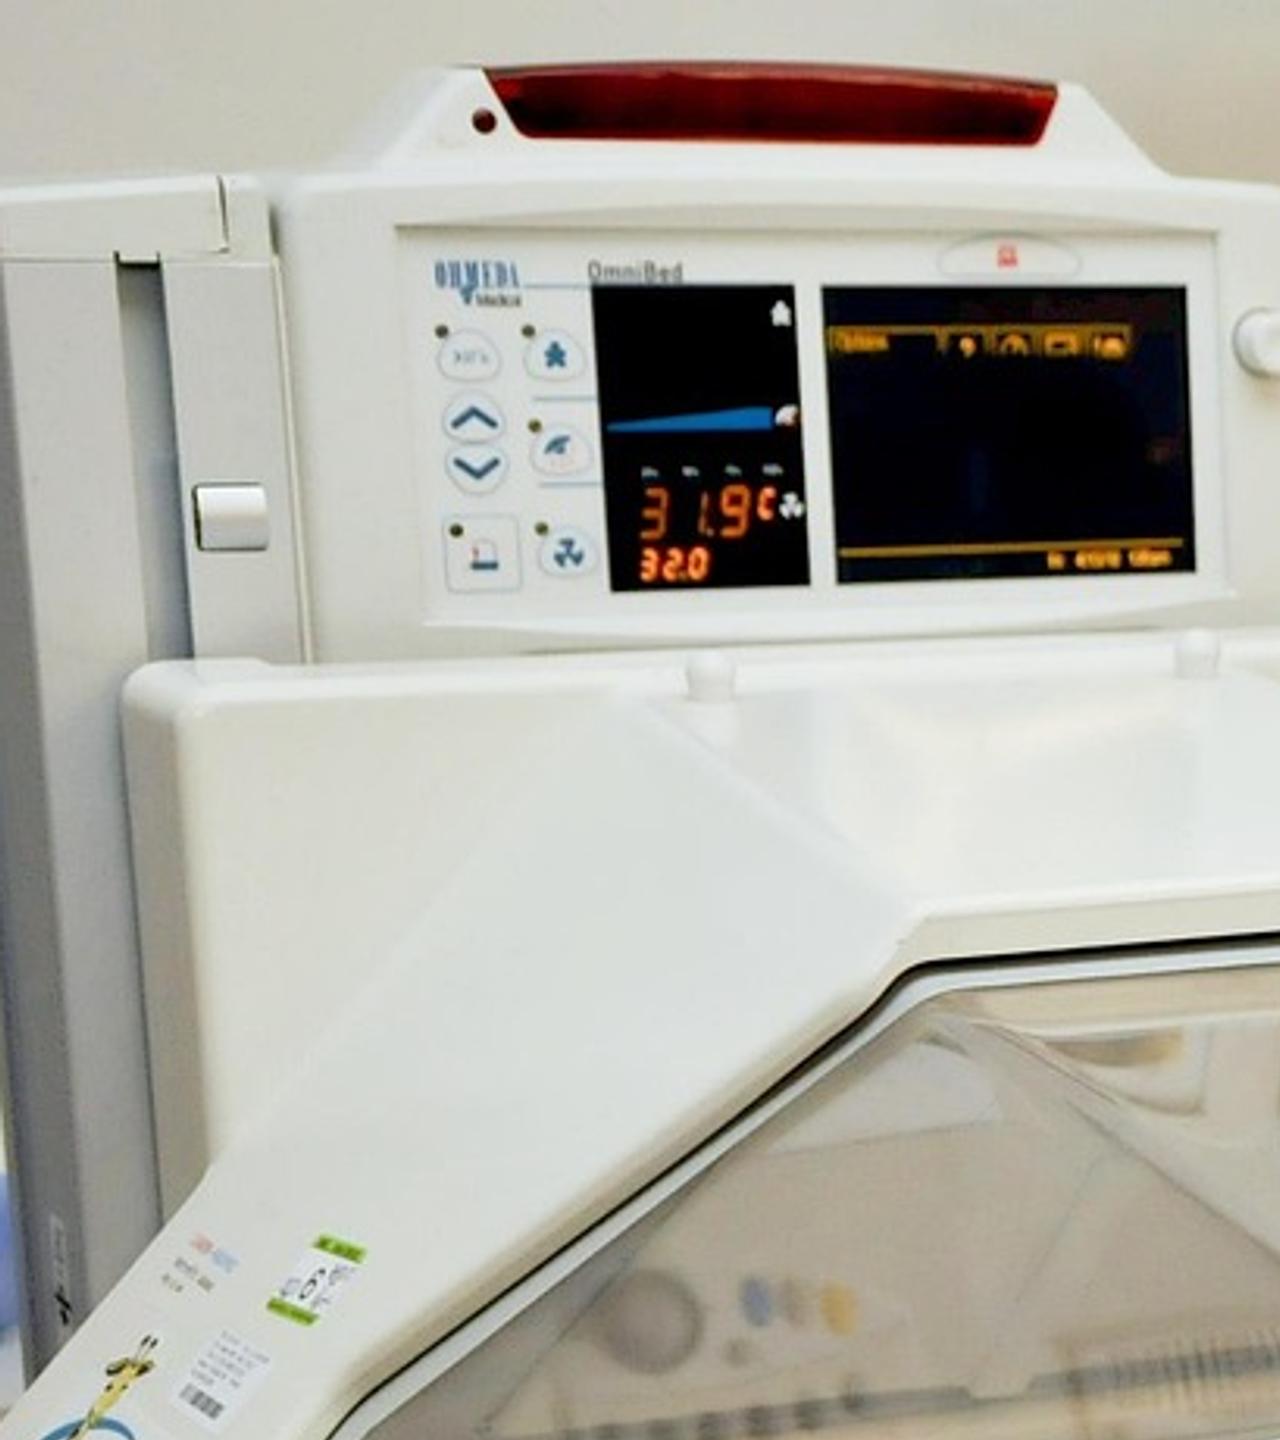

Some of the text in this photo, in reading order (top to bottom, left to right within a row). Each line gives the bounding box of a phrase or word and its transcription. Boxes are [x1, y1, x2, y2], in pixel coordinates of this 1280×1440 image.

[434, 259, 520, 289] OHMEDA
[588, 259, 683, 284] OmniBed
[640, 547, 710, 582] 32.0
